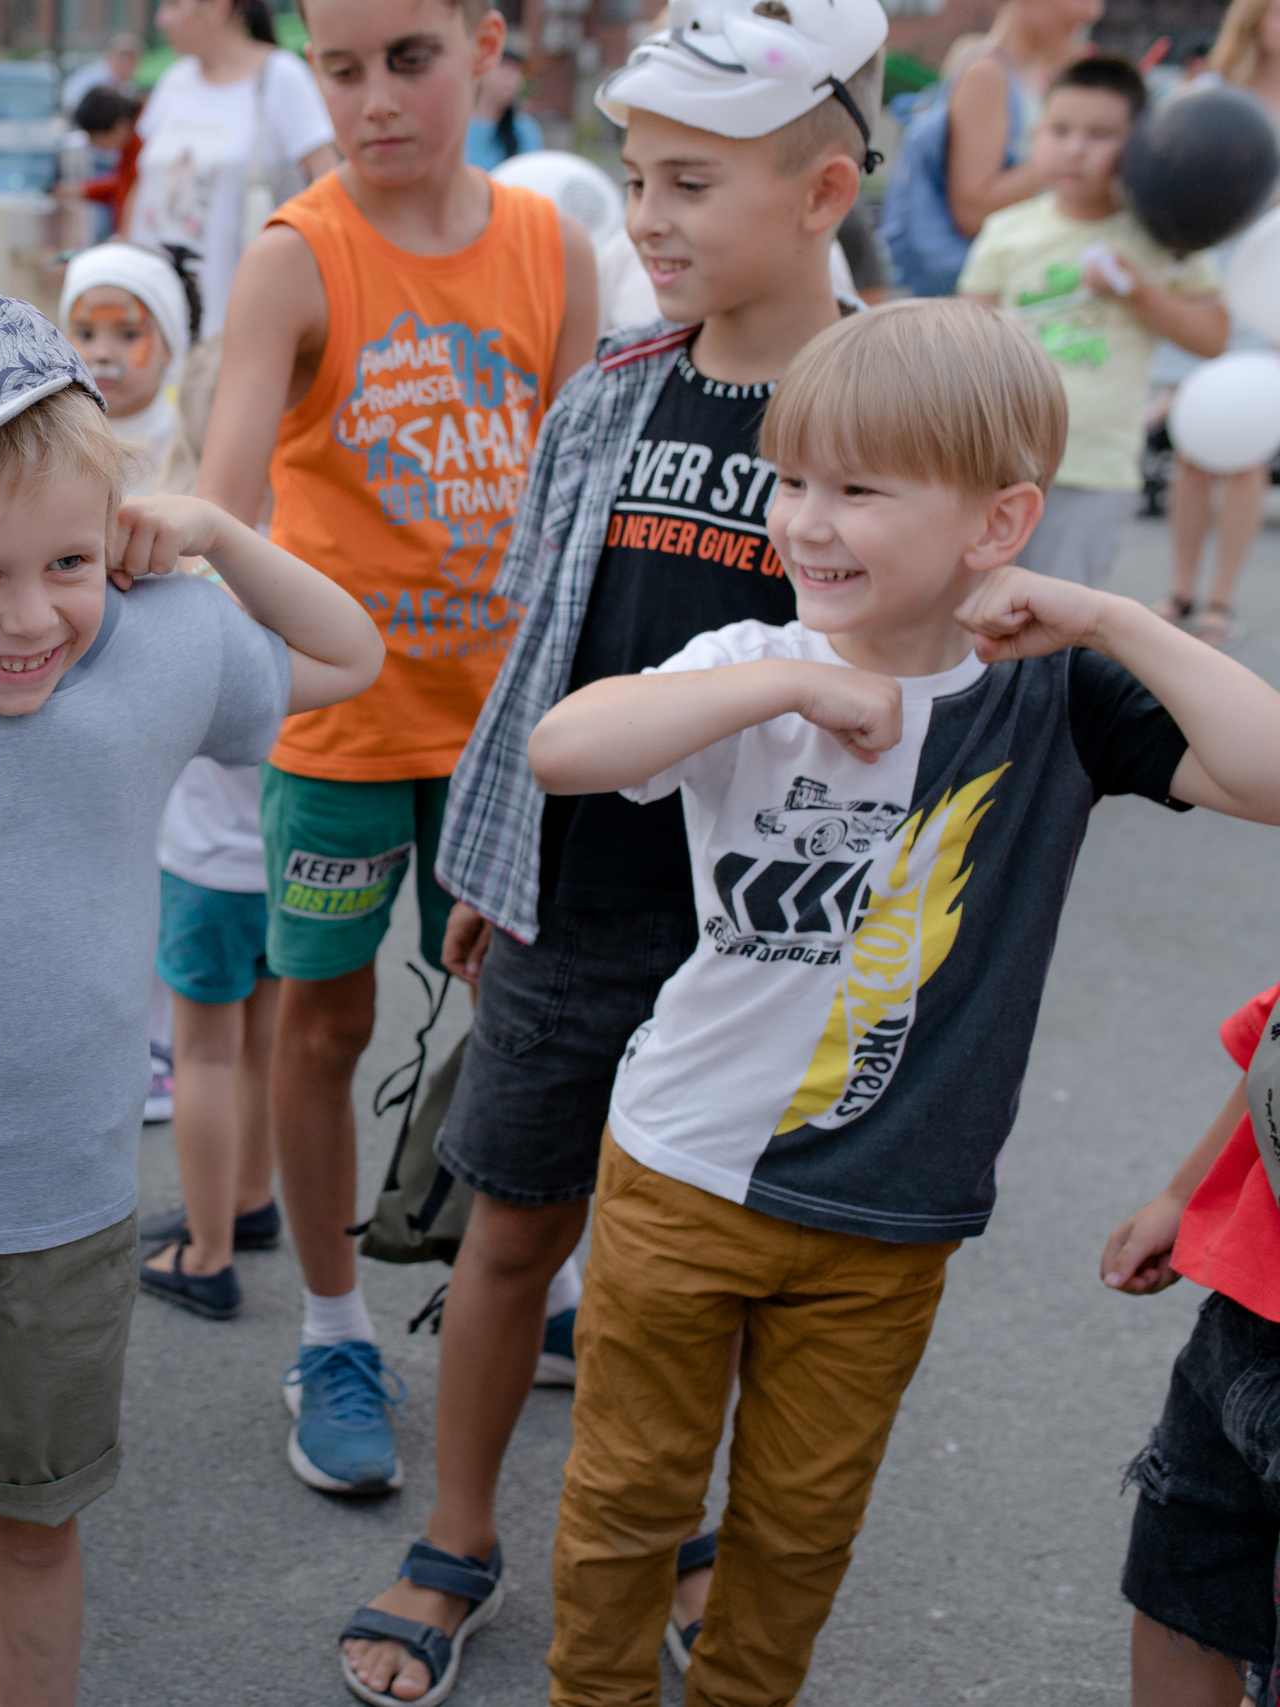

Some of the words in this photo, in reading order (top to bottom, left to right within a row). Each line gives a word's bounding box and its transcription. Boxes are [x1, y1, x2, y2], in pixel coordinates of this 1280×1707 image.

[621, 515, 699, 557] NEVER
[698, 526, 761, 571] GIVE
[291, 855, 355, 885] KEEP
